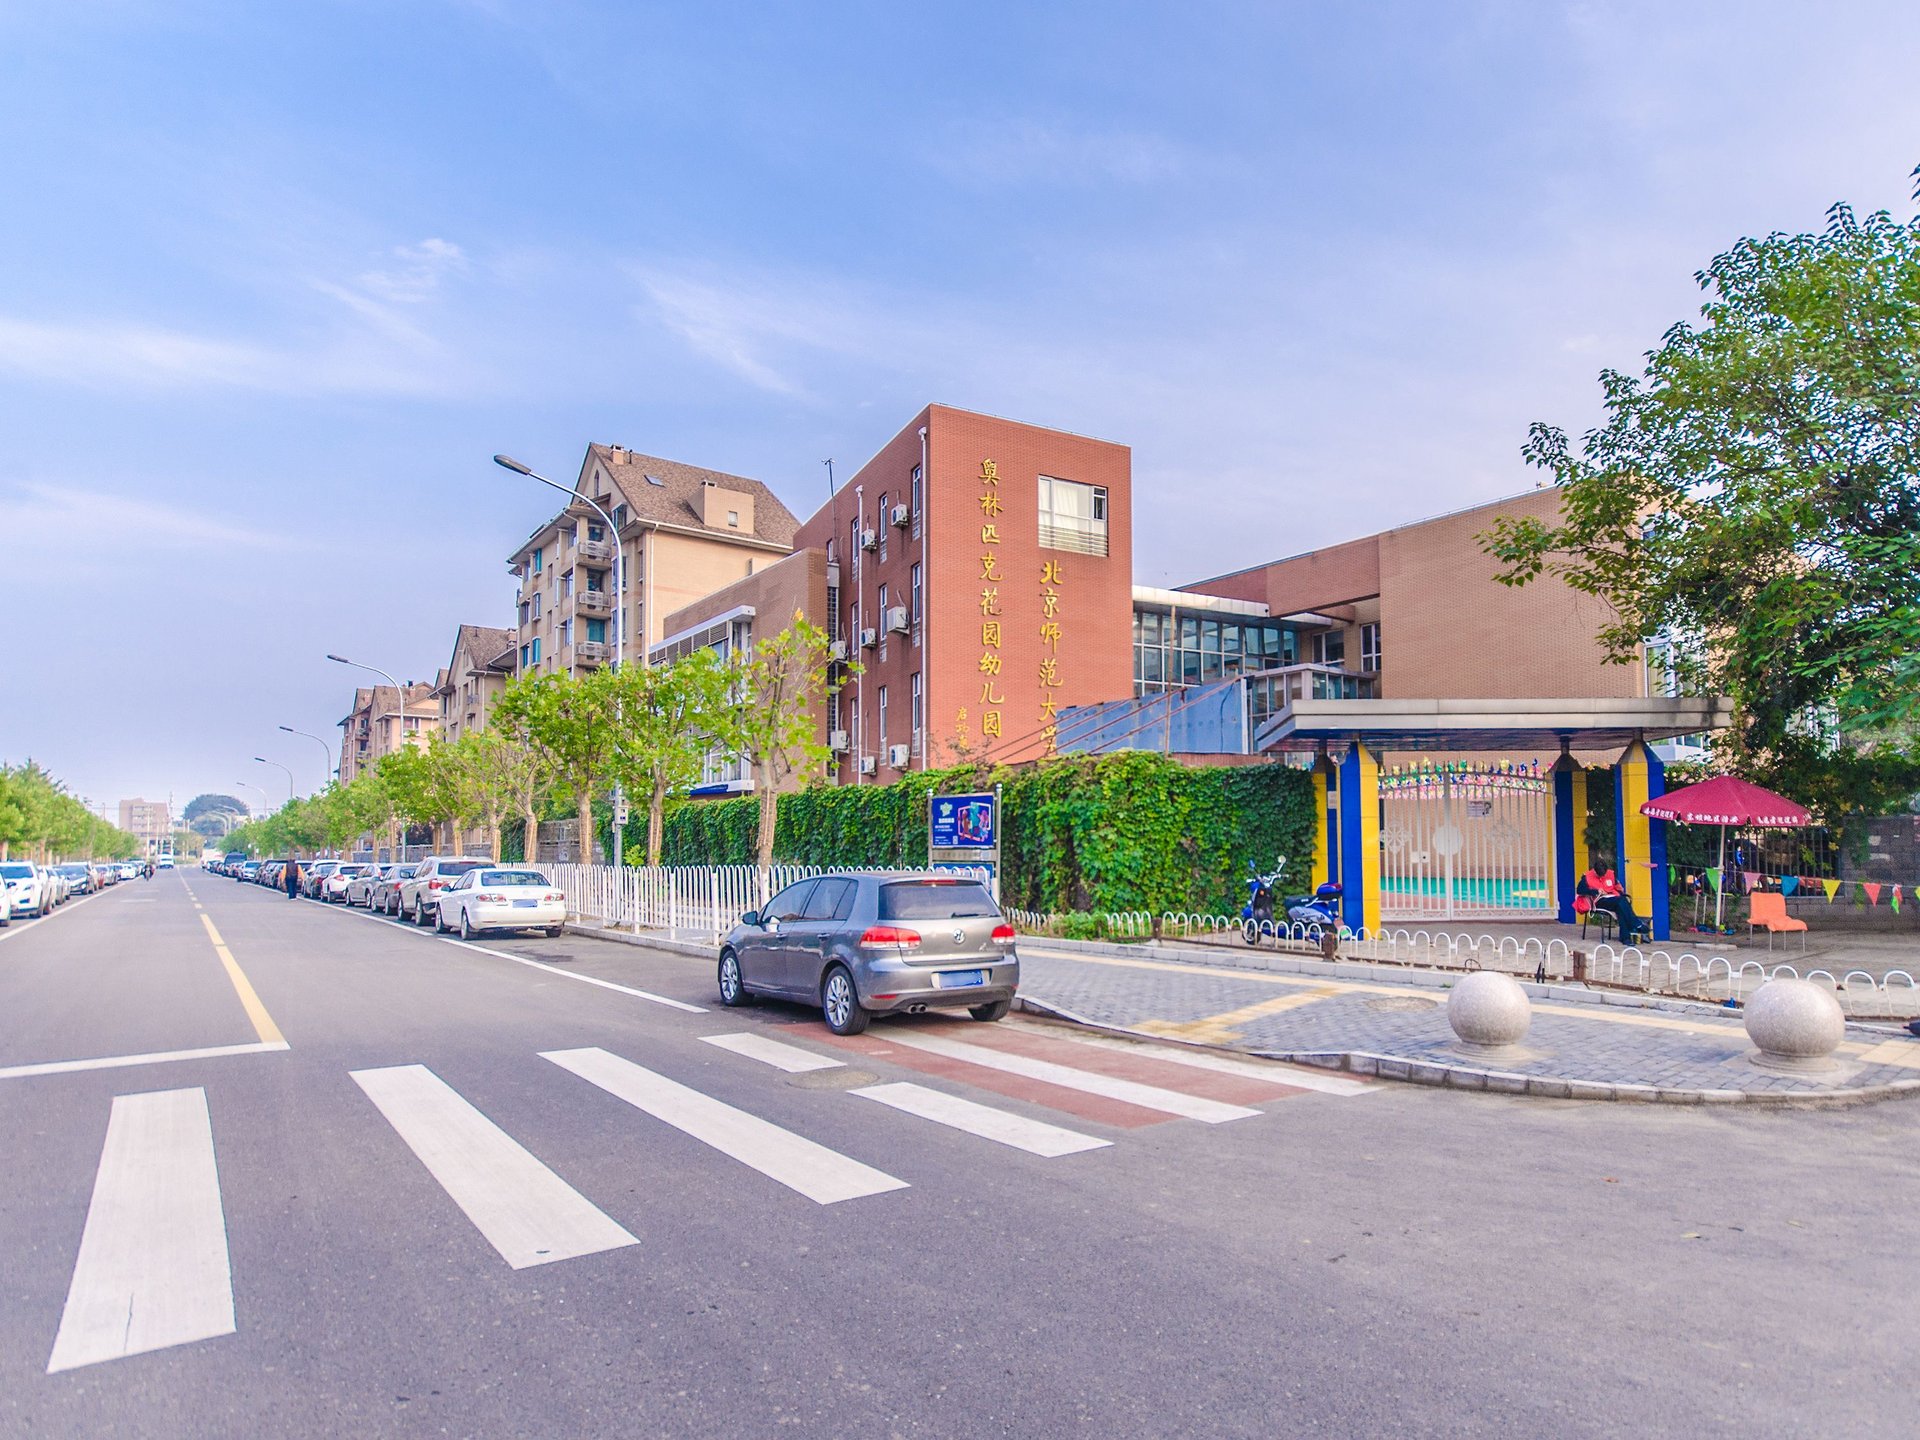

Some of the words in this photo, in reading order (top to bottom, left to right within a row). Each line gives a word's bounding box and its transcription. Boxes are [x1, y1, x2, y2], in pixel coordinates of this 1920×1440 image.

[979, 457, 1004, 738] 奥林匹克花园幼儿园
[1039, 559, 1063, 755] 北京师范大学
